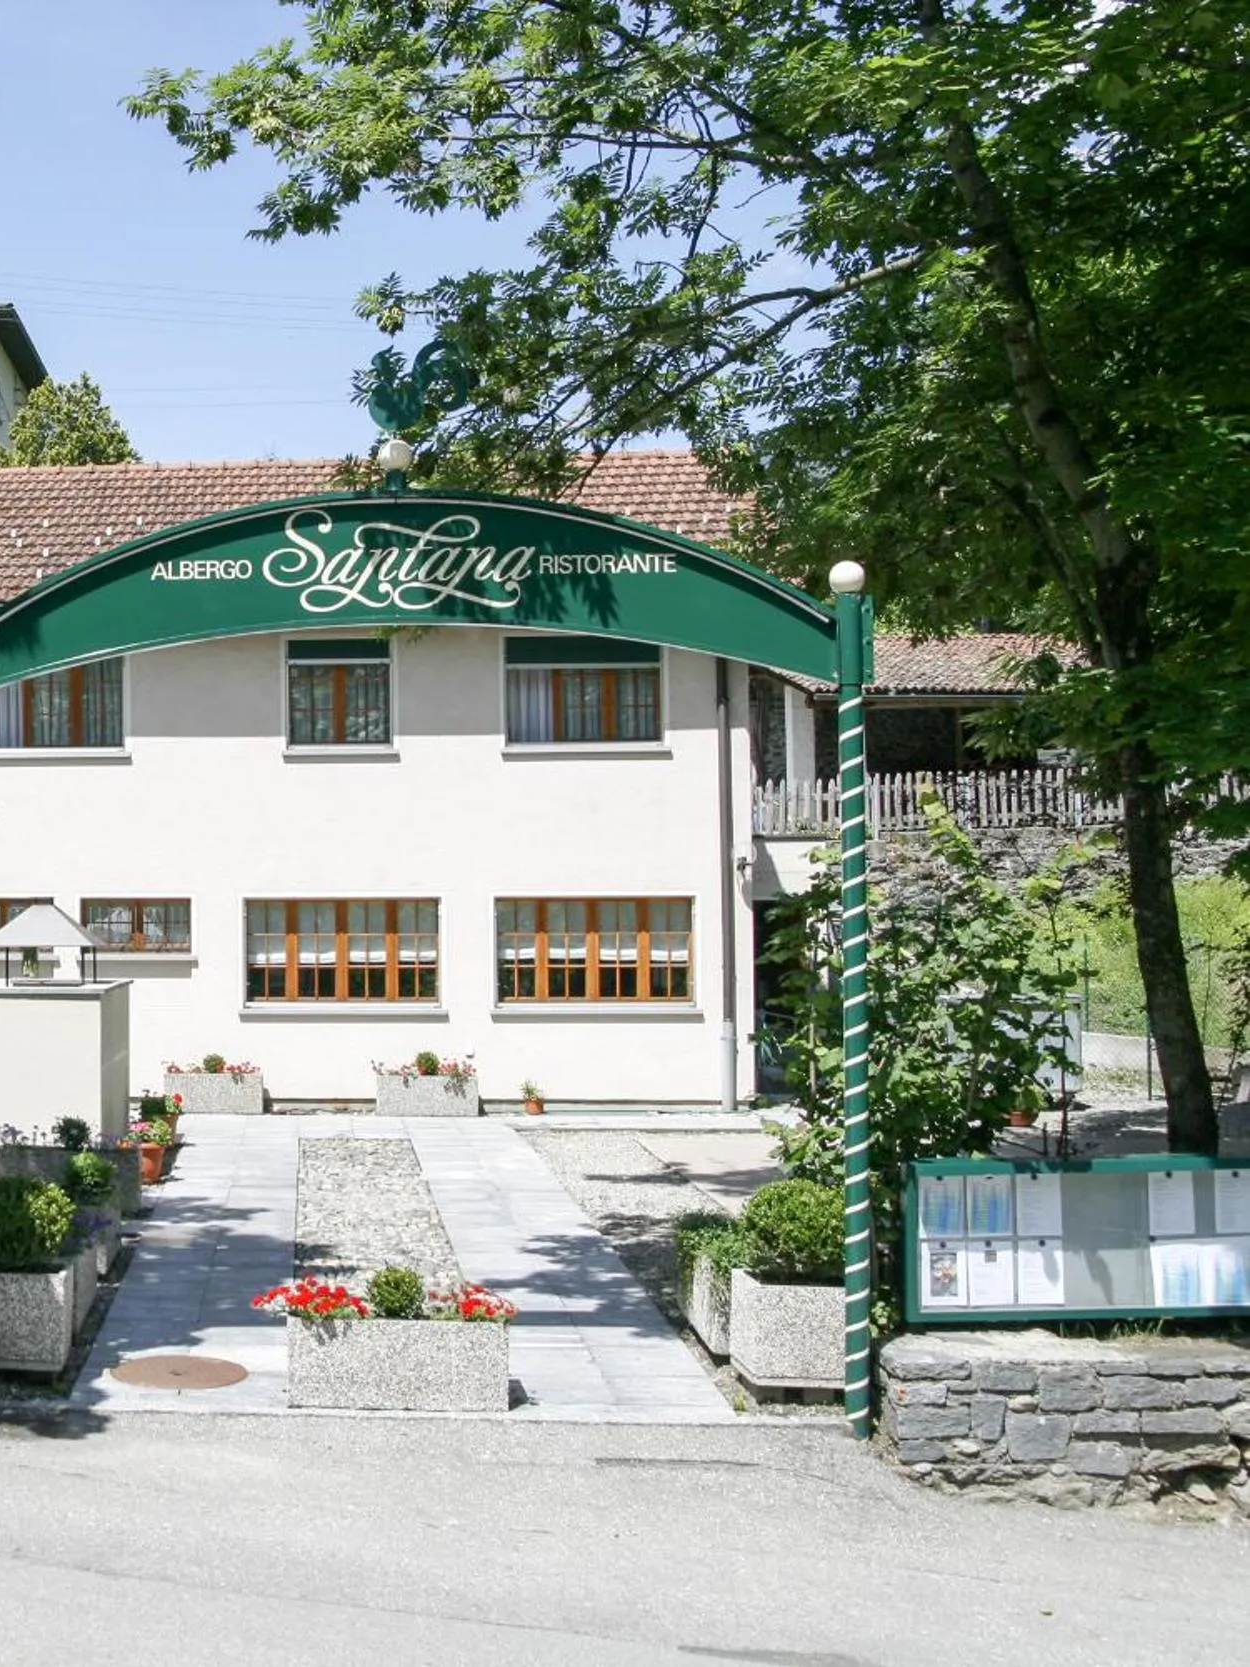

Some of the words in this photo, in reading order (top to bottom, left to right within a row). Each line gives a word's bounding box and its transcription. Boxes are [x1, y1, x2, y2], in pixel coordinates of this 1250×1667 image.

[150, 559, 253, 581] ALBERGO
[262, 509, 536, 613] Santana
[538, 553, 678, 575] RISTORANTE
